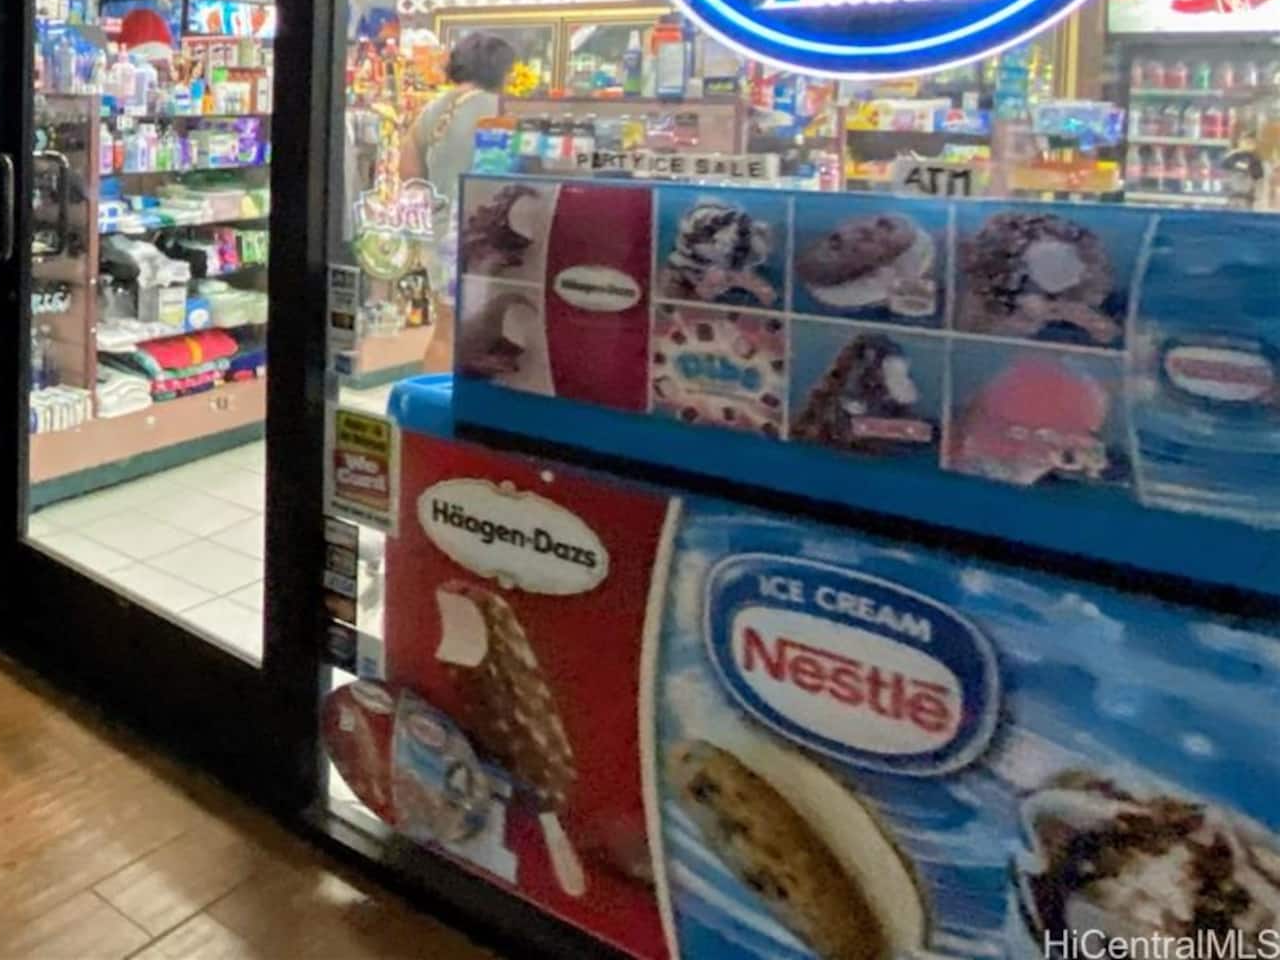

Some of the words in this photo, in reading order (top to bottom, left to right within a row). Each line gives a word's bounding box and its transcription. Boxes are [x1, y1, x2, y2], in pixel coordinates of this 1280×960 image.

[649, 156, 684, 174] ICE
[695, 158, 763, 178] SALE
[904, 166, 973, 197] ATM
[432, 499, 598, 569] Häagen-Dazs
[757, 575, 806, 604] ICE
[814, 585, 933, 643] CREAM
